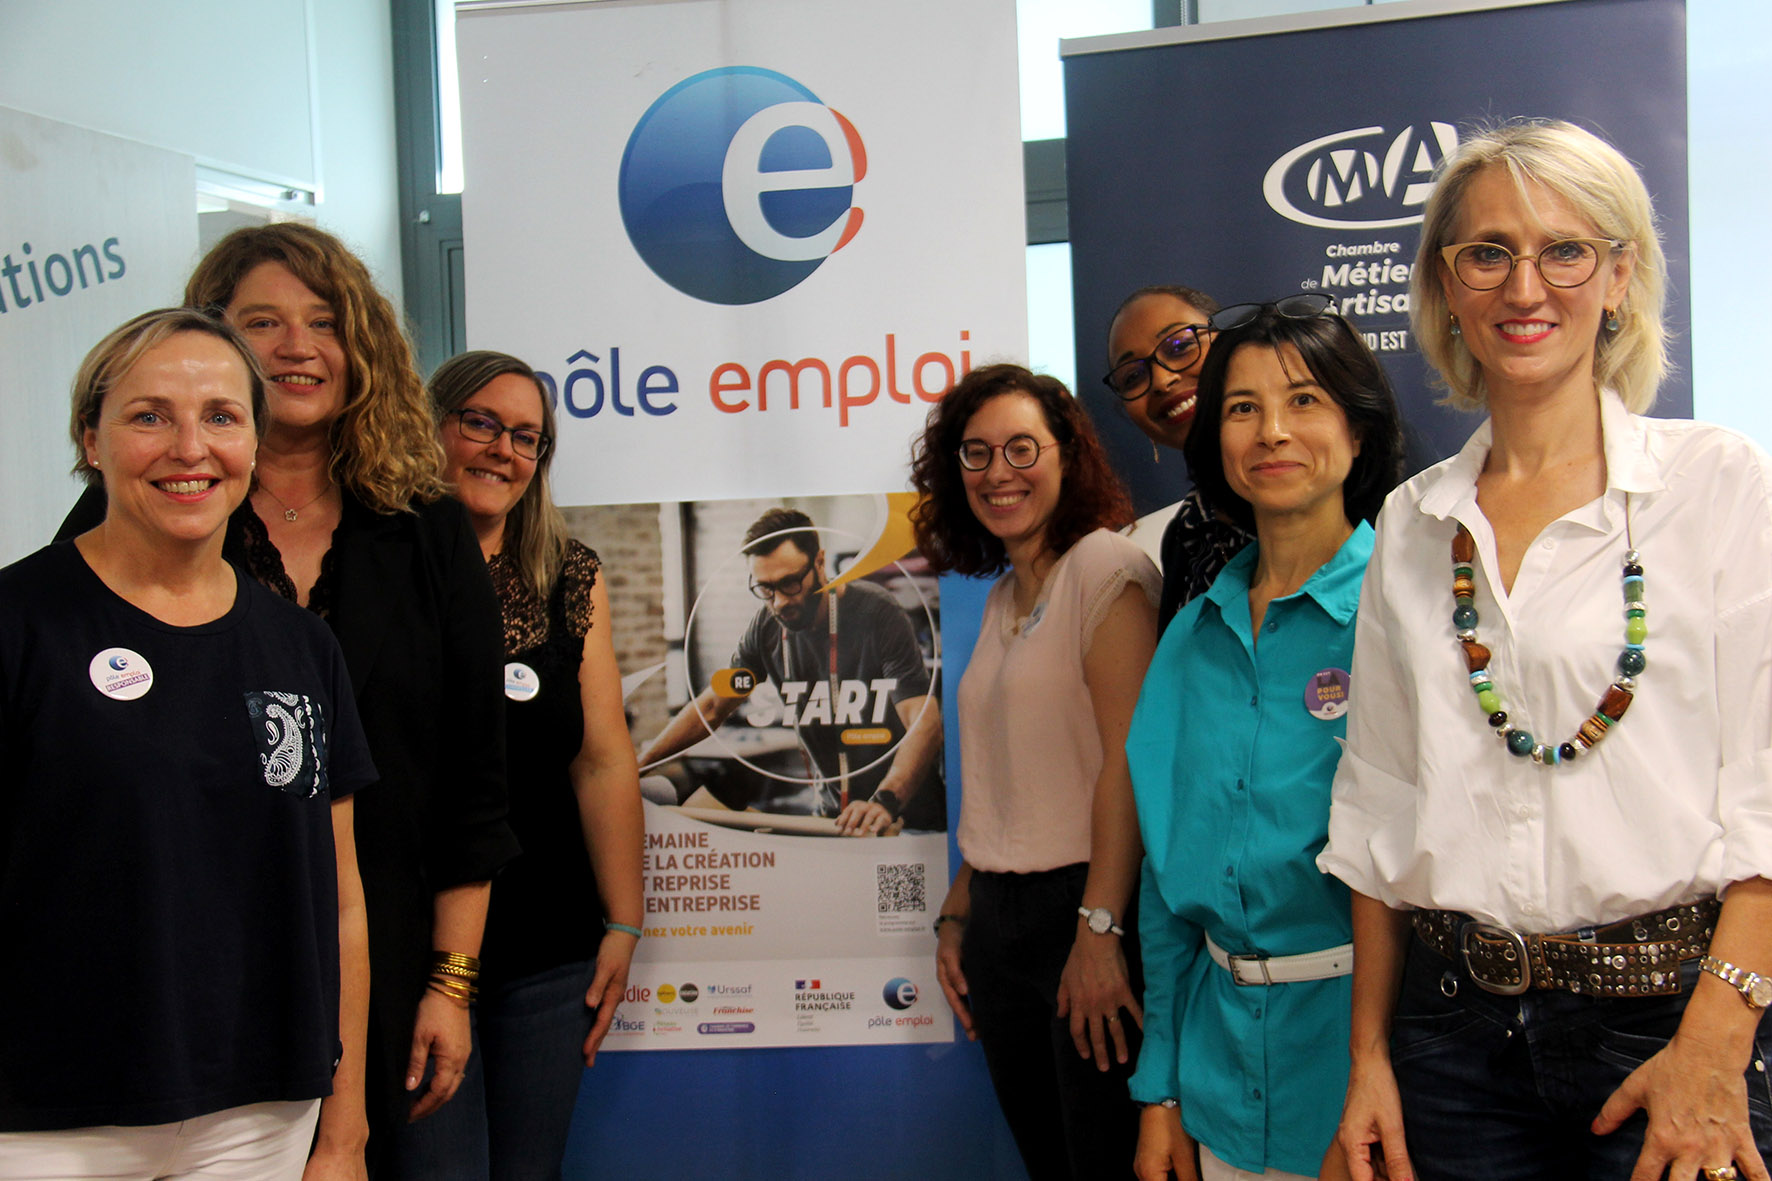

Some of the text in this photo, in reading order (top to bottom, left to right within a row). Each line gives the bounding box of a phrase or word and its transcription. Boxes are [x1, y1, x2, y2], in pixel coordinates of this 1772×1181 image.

[1326, 241, 1400, 258] Chambre
[1301, 258, 1411, 290] de Métie
[1380, 330, 1408, 351] EST
[709, 330, 971, 428] emploi
[734, 676, 751, 689] RE
[1316, 685, 1342, 695] POUR
[747, 678, 898, 728] START
[655, 854, 678, 870] LA
[683, 848, 775, 869] CRÉATION
[653, 874, 730, 891] REPRISE
[646, 894, 760, 913] ENTREPRISE
[643, 921, 755, 937] nez votre avenir
[717, 984, 752, 994] Urssaf
[795, 991, 855, 1001] RÉPUBLIQUE
[713, 1006, 755, 1015] Franchise
[795, 1001, 851, 1012] FRANÇAISE
[622, 1021, 645, 1031] BGE
[868, 1015, 934, 1029] pôle emploi
